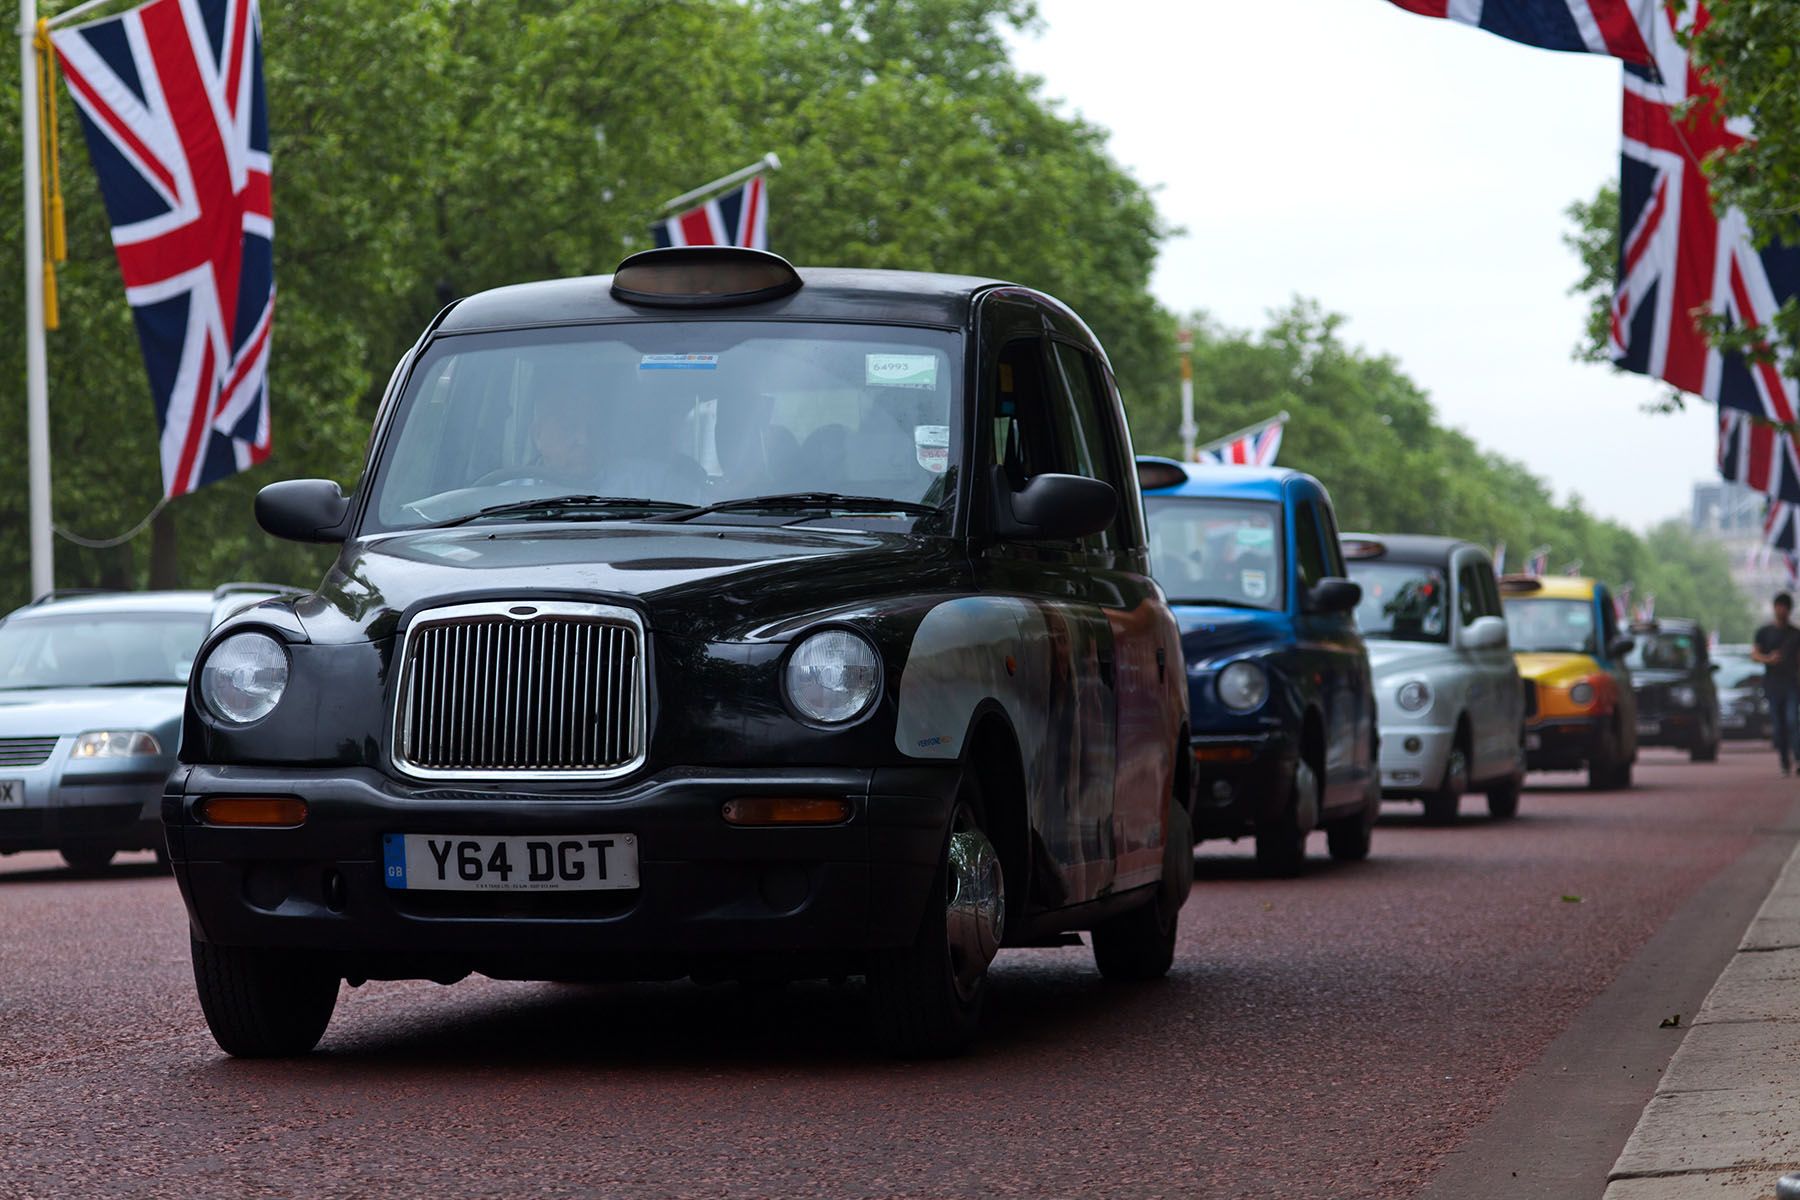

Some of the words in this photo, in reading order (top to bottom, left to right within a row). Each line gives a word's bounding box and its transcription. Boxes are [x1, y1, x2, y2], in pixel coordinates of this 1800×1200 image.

[387, 866, 403, 877] GB
[427, 839, 513, 882] Y64
[526, 839, 615, 882] DGT
